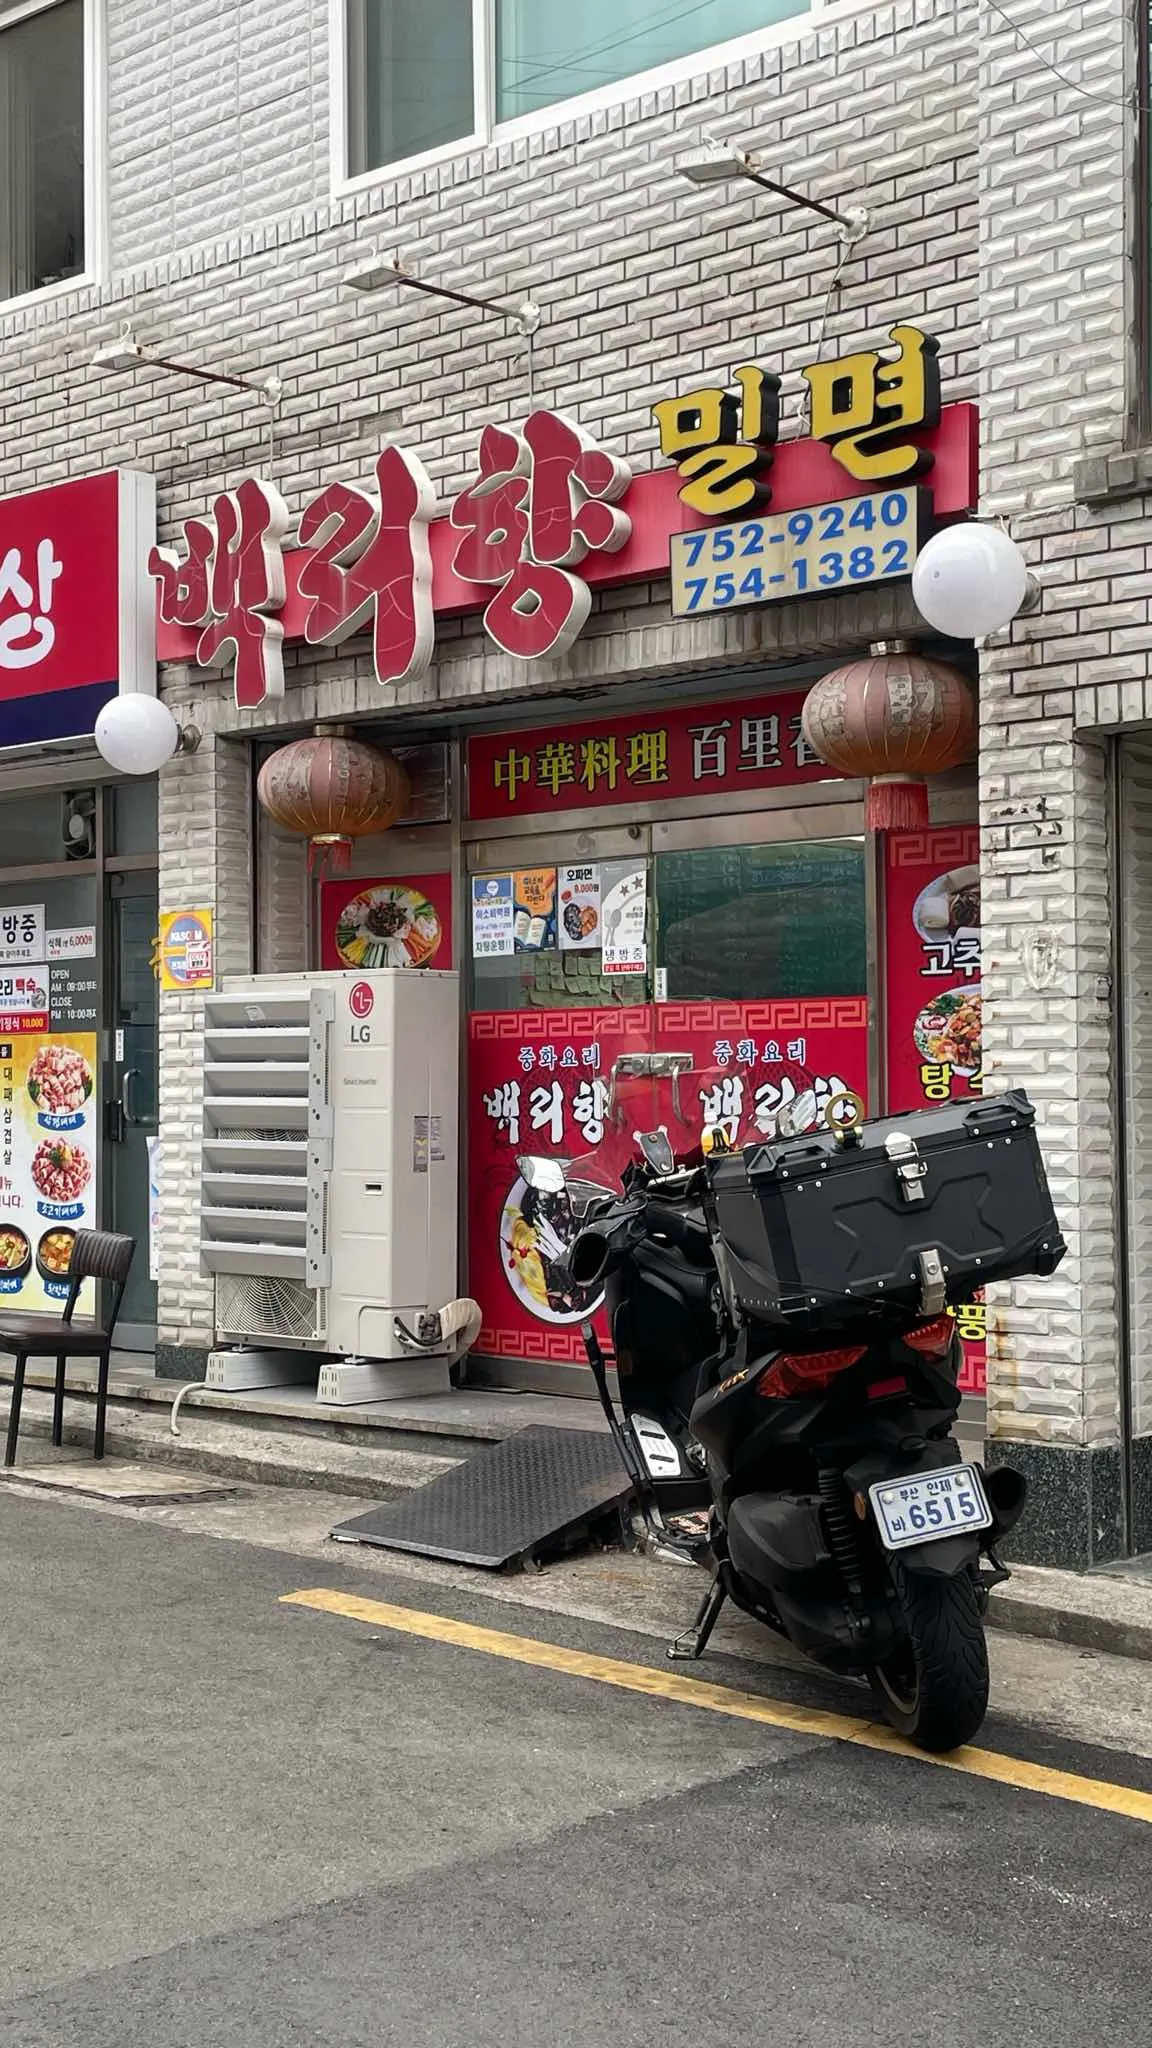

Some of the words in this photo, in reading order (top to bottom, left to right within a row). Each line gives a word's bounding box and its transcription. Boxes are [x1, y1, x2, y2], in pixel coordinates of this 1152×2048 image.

[651, 325, 934, 516] 밀면
[682, 494, 908, 568] 752-9240
[148, 409, 622, 710] 백리향
[683, 539, 908, 610] 754-1382
[493, 728, 669, 801] 中華料理
[51, 969, 70, 980] OPEN
[51, 996, 72, 1007] CLOSE
[350, 1025, 371, 1043] LG
[712, 1036, 808, 1068] 중화요리
[518, 1042, 601, 1072] 중화요리
[483, 1077, 611, 1144] 백리향
[946, 1302, 986, 1341] 뽕
[899, 1487, 919, 1502] 부산
[908, 1491, 976, 1530] 6515
